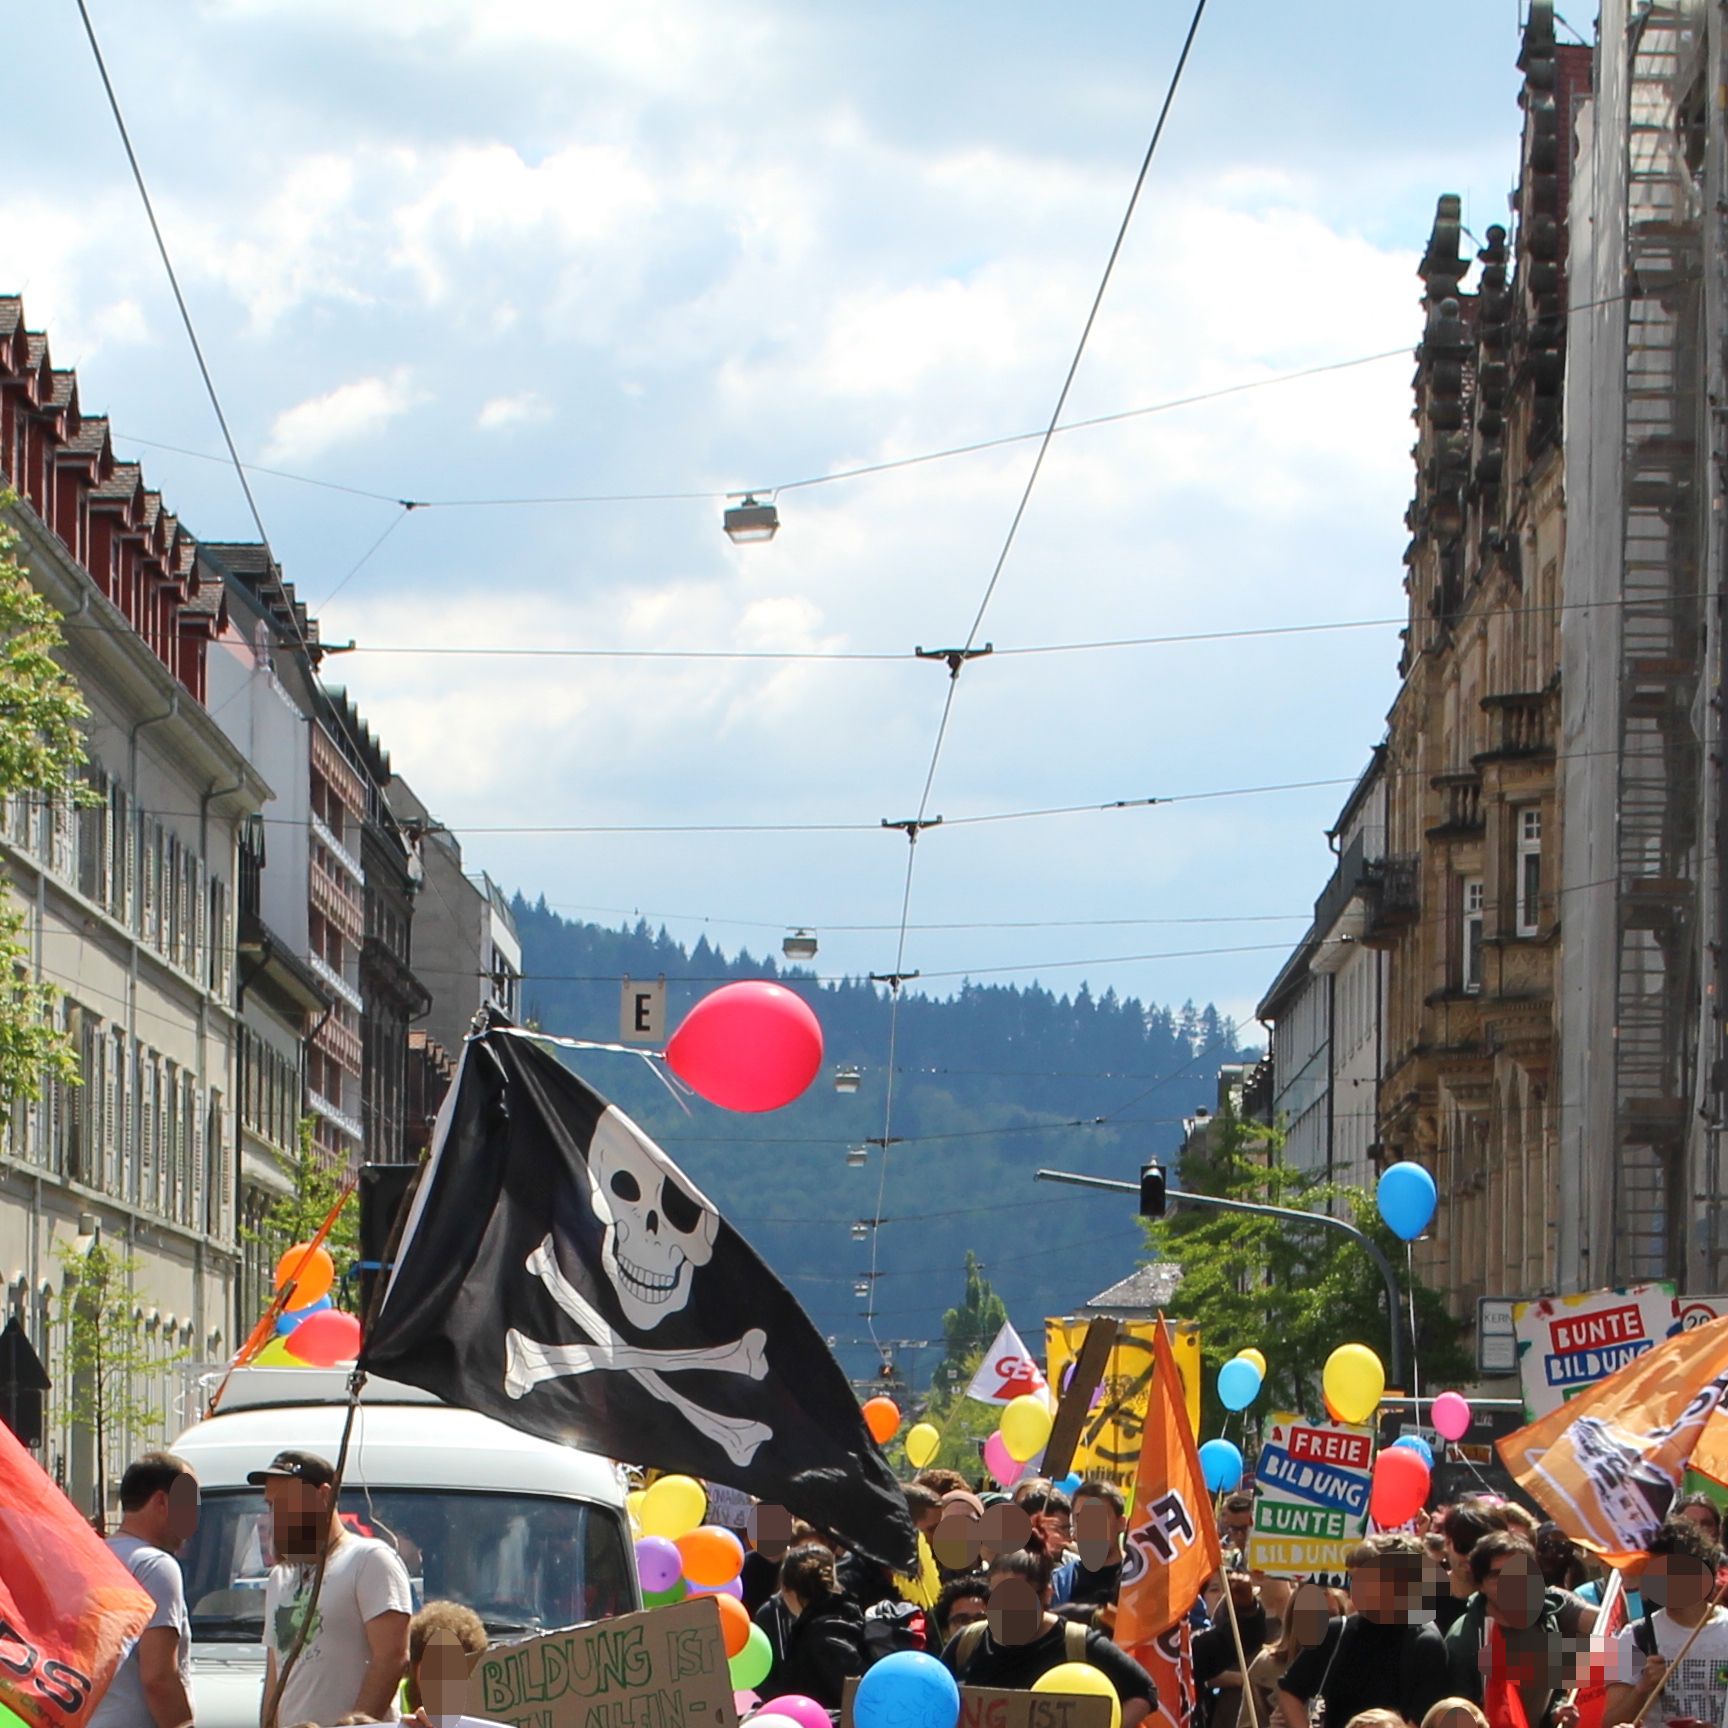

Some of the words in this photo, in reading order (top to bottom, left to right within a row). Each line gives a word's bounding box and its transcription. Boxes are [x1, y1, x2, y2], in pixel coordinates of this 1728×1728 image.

[635, 993, 651, 1032] E
[1557, 1311, 1641, 1349] BUNTE
[1294, 1432, 1363, 1463] FREIE
[1265, 1454, 1364, 1508] BILDUNG
[1261, 1506, 1342, 1537] BUNTE
[482, 1624, 653, 1714] BILDUNG
[665, 1624, 720, 1684] IST
